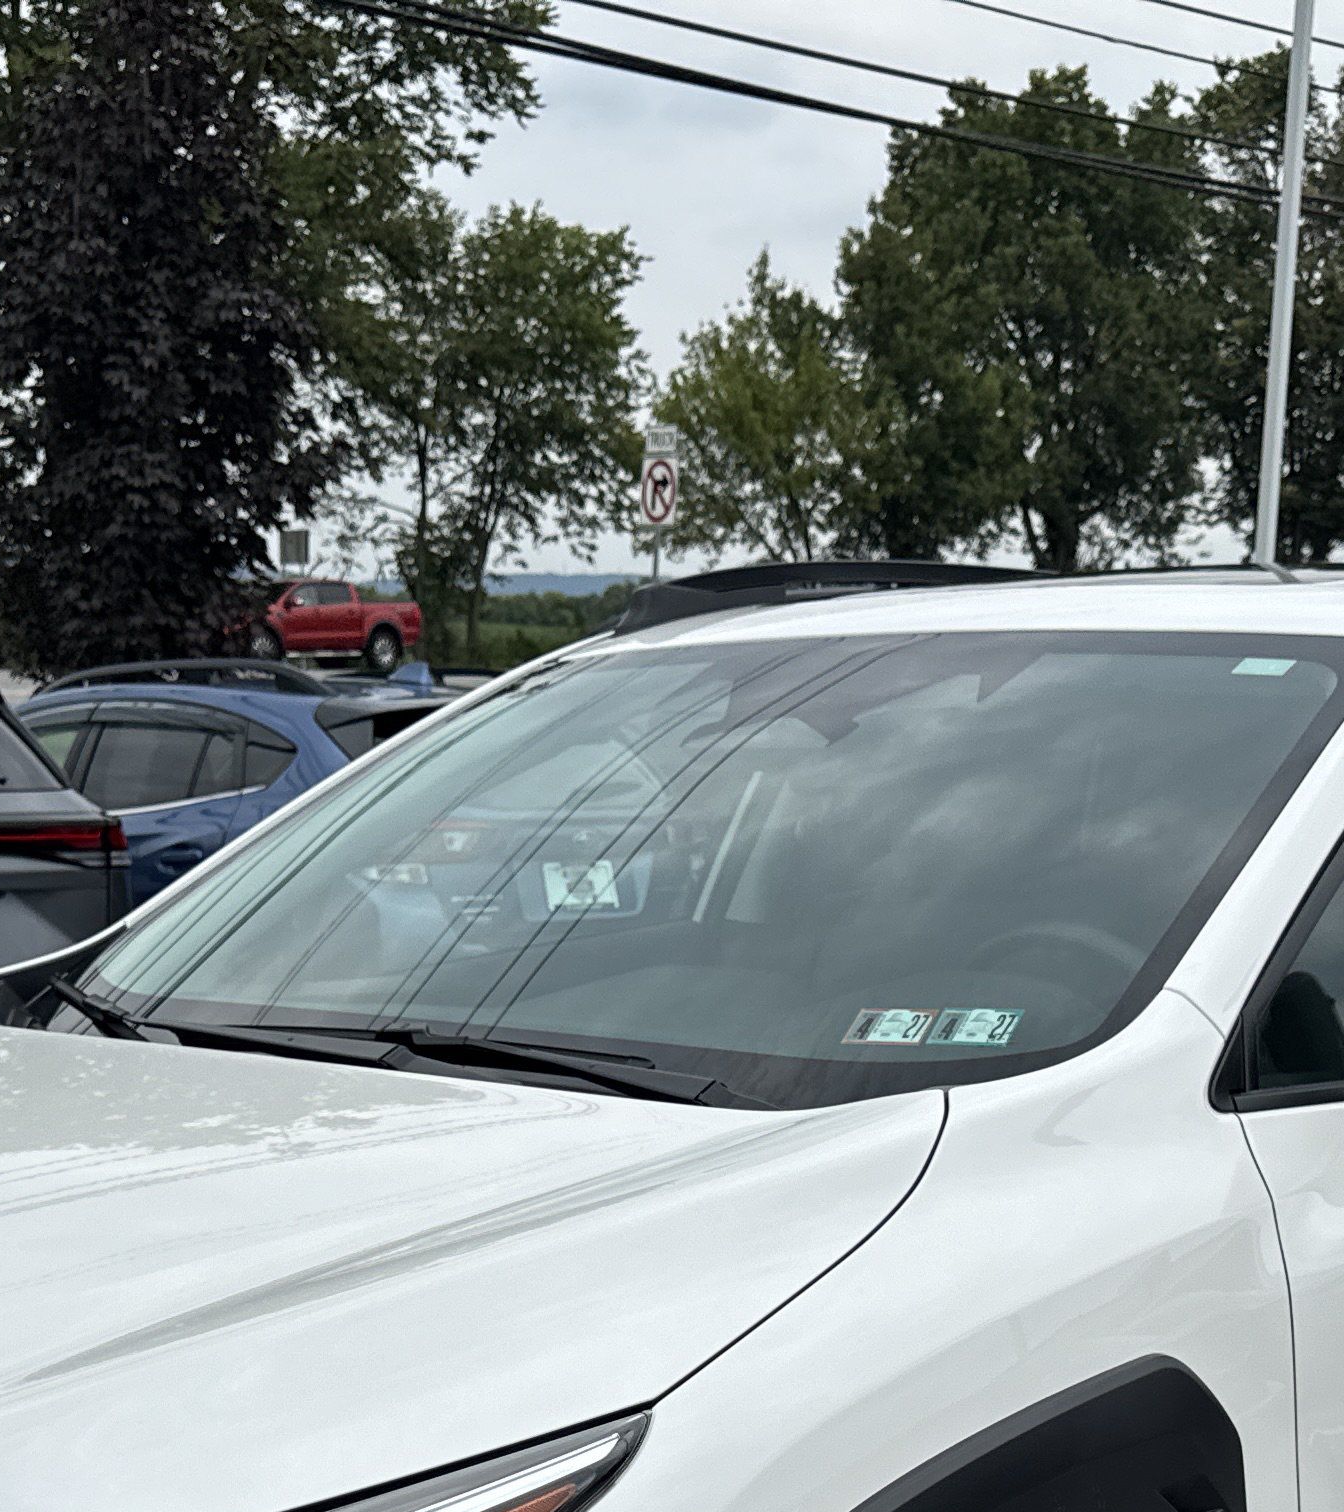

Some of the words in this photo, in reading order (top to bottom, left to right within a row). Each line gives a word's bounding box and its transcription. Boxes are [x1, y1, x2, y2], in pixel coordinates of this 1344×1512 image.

[857, 1016, 874, 1040] 4
[901, 1014, 931, 1040] 27
[988, 1014, 1017, 1040] 27
